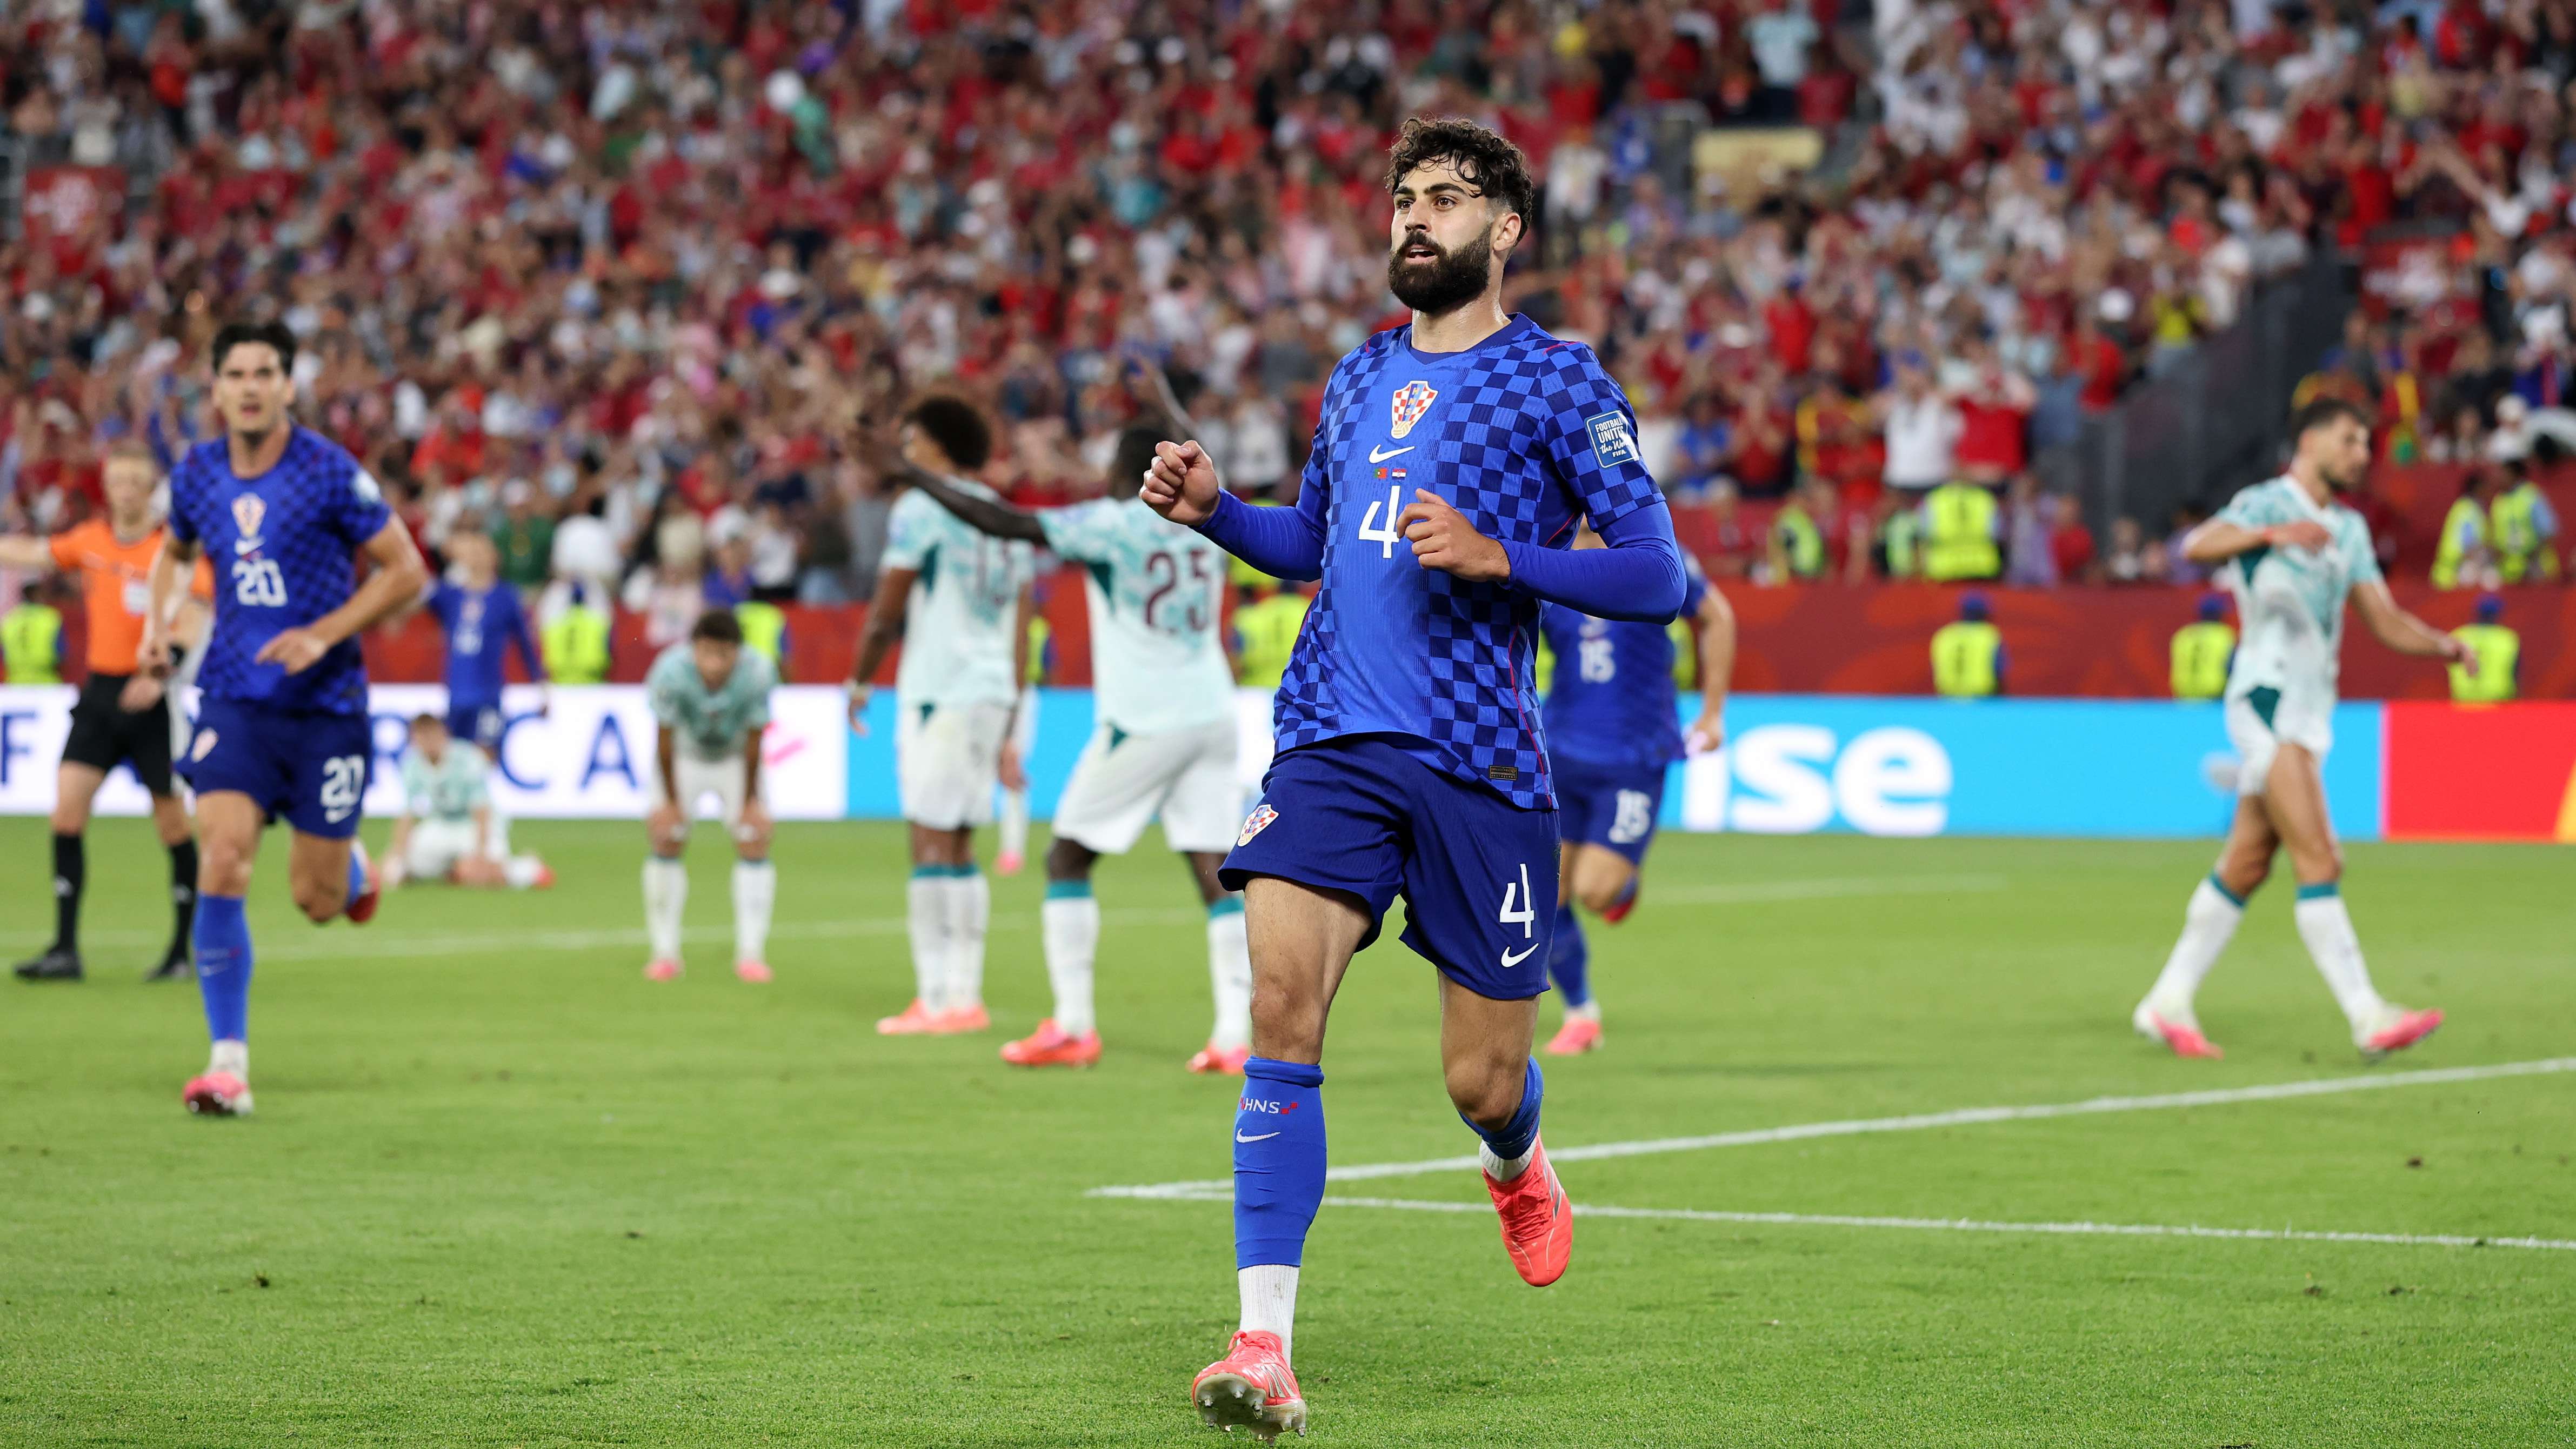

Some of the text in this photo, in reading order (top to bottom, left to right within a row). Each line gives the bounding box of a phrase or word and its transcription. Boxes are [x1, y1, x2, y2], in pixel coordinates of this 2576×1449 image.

[1595, 418, 1623, 432] FOOTBALL
[1600, 443, 1612, 454] the
[1358, 485, 1400, 558] 4
[231, 559, 288, 607] 20
[1145, 548, 1210, 633] 25
[1578, 639, 1616, 684] 15
[321, 754, 365, 807] 20
[1615, 789, 1651, 837] 15
[1500, 864, 1534, 939] 4
[1244, 1098, 1280, 1114] HNS
